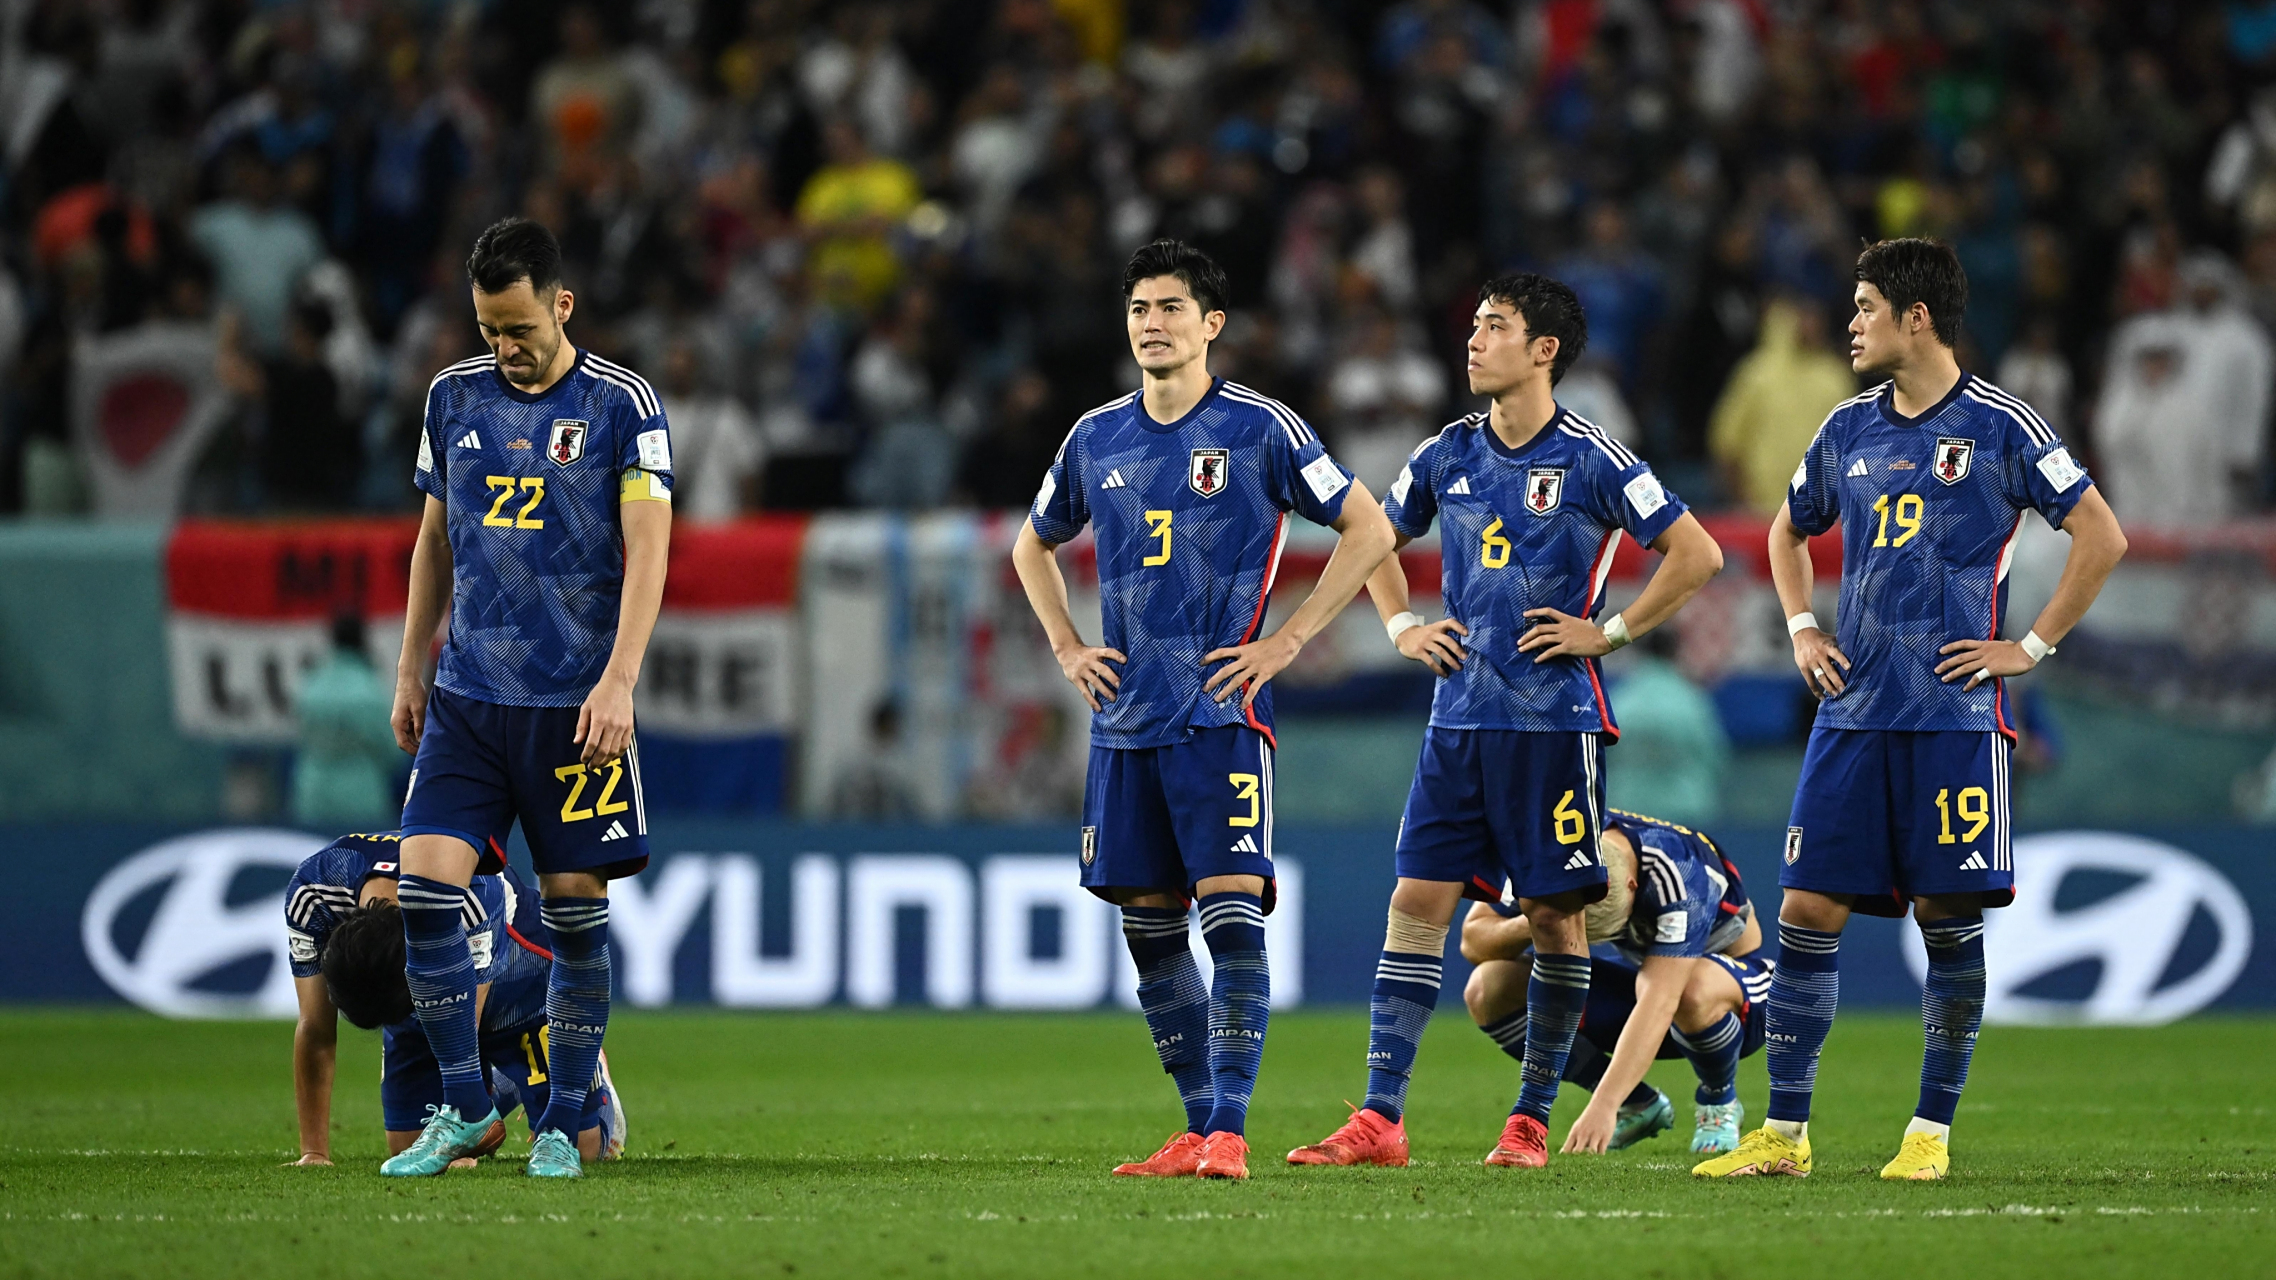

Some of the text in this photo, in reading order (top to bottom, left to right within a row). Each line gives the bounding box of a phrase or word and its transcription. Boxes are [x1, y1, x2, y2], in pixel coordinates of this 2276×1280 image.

[555, 450, 572, 459] JFA
[1942, 468, 1958, 477] JFA
[483, 475, 545, 530] 22
[1199, 481, 1216, 489] JFA
[1533, 499, 1549, 507] JFA
[1143, 510, 1173, 567] 3
[1481, 517, 1511, 569] 6
[1872, 494, 1924, 548] 19
[555, 757, 629, 823] 22
[1229, 773, 1260, 827] 3
[1935, 786, 1990, 845] 19
[1553, 790, 1586, 845] 6
[1209, 1028, 1262, 1040] JAPAN
